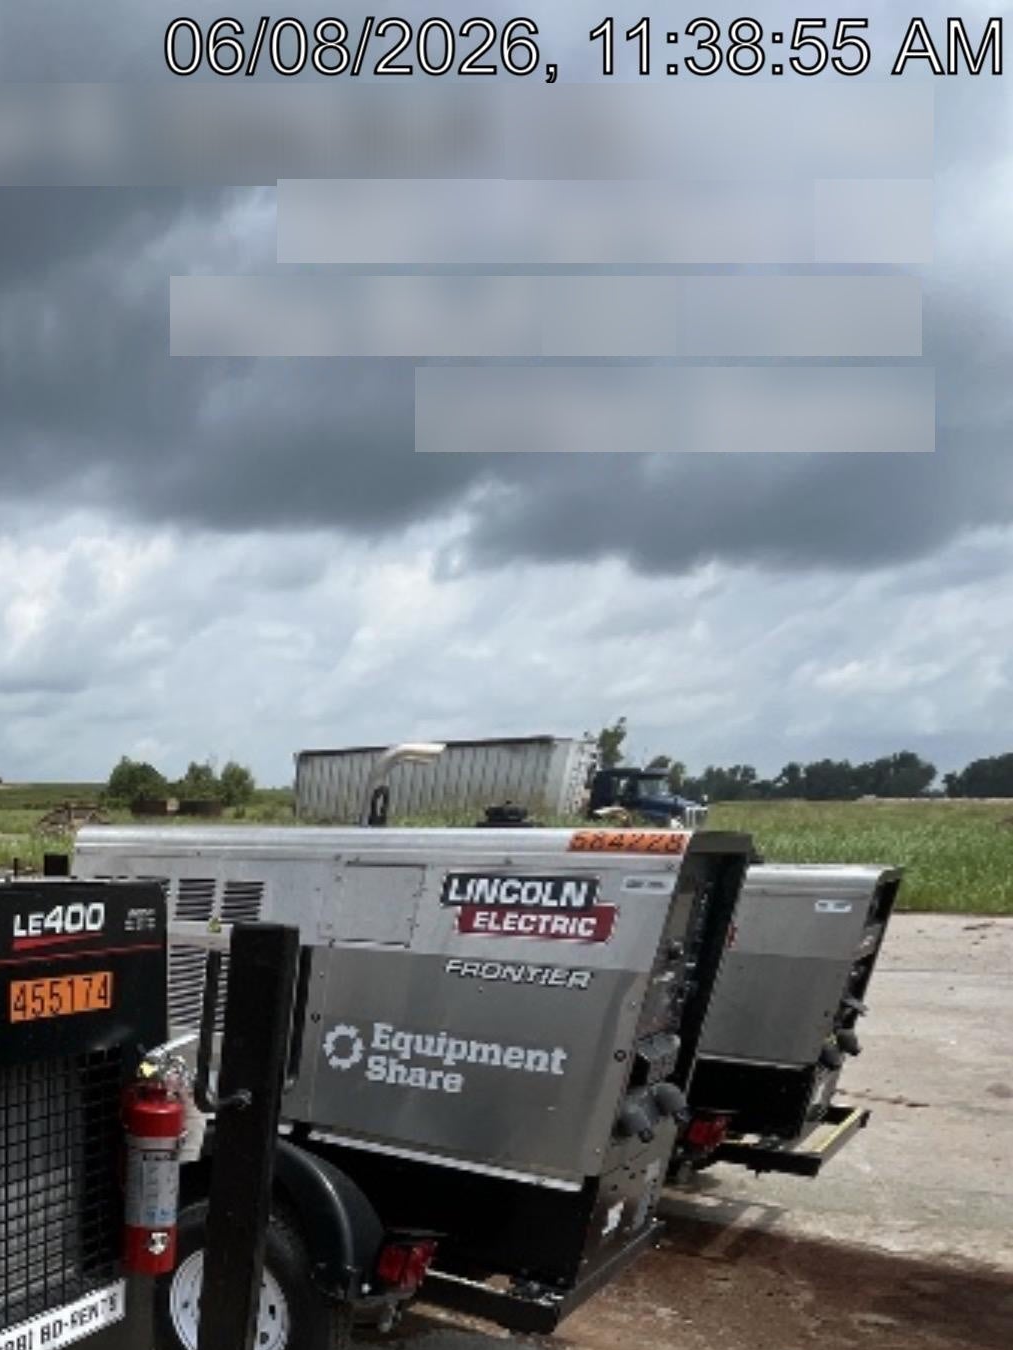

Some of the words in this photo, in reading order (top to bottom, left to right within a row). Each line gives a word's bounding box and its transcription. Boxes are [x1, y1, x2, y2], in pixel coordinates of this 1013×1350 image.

[448, 877, 589, 907] LINCOLN
[13, 902, 106, 937] LE400
[472, 910, 597, 937] ELECTRIC
[444, 958, 592, 990] FRONTIER
[13, 973, 109, 1019] 455174
[370, 1022, 568, 1076] Equipment
[364, 1054, 465, 1094] Share
